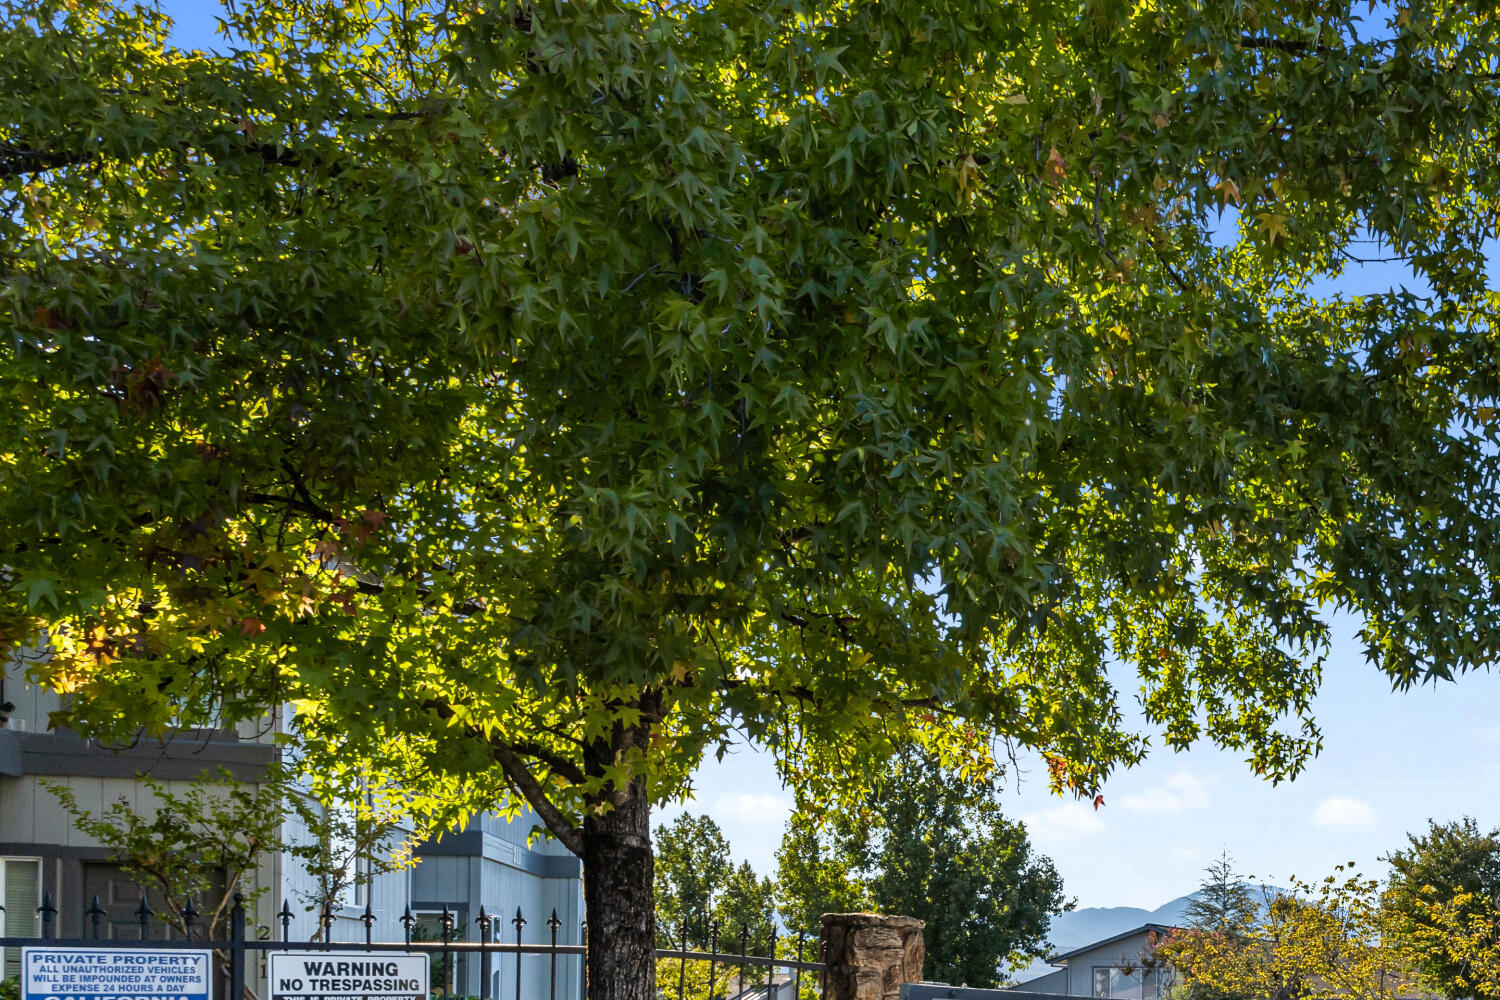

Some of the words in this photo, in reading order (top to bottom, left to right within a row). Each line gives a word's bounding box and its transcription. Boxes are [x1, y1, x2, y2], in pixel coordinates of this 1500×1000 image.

[33, 955, 107, 964] PRIVATE
[113, 956, 201, 965] PROPERTY
[40, 965, 59, 973] ALL
[63, 965, 144, 973] UNAUTHORIZED
[304, 962, 398, 976] WARNING
[52, 984, 100, 992] EXPENSE
[280, 979, 303, 991] NO
[309, 979, 419, 991] TRESPASSING
